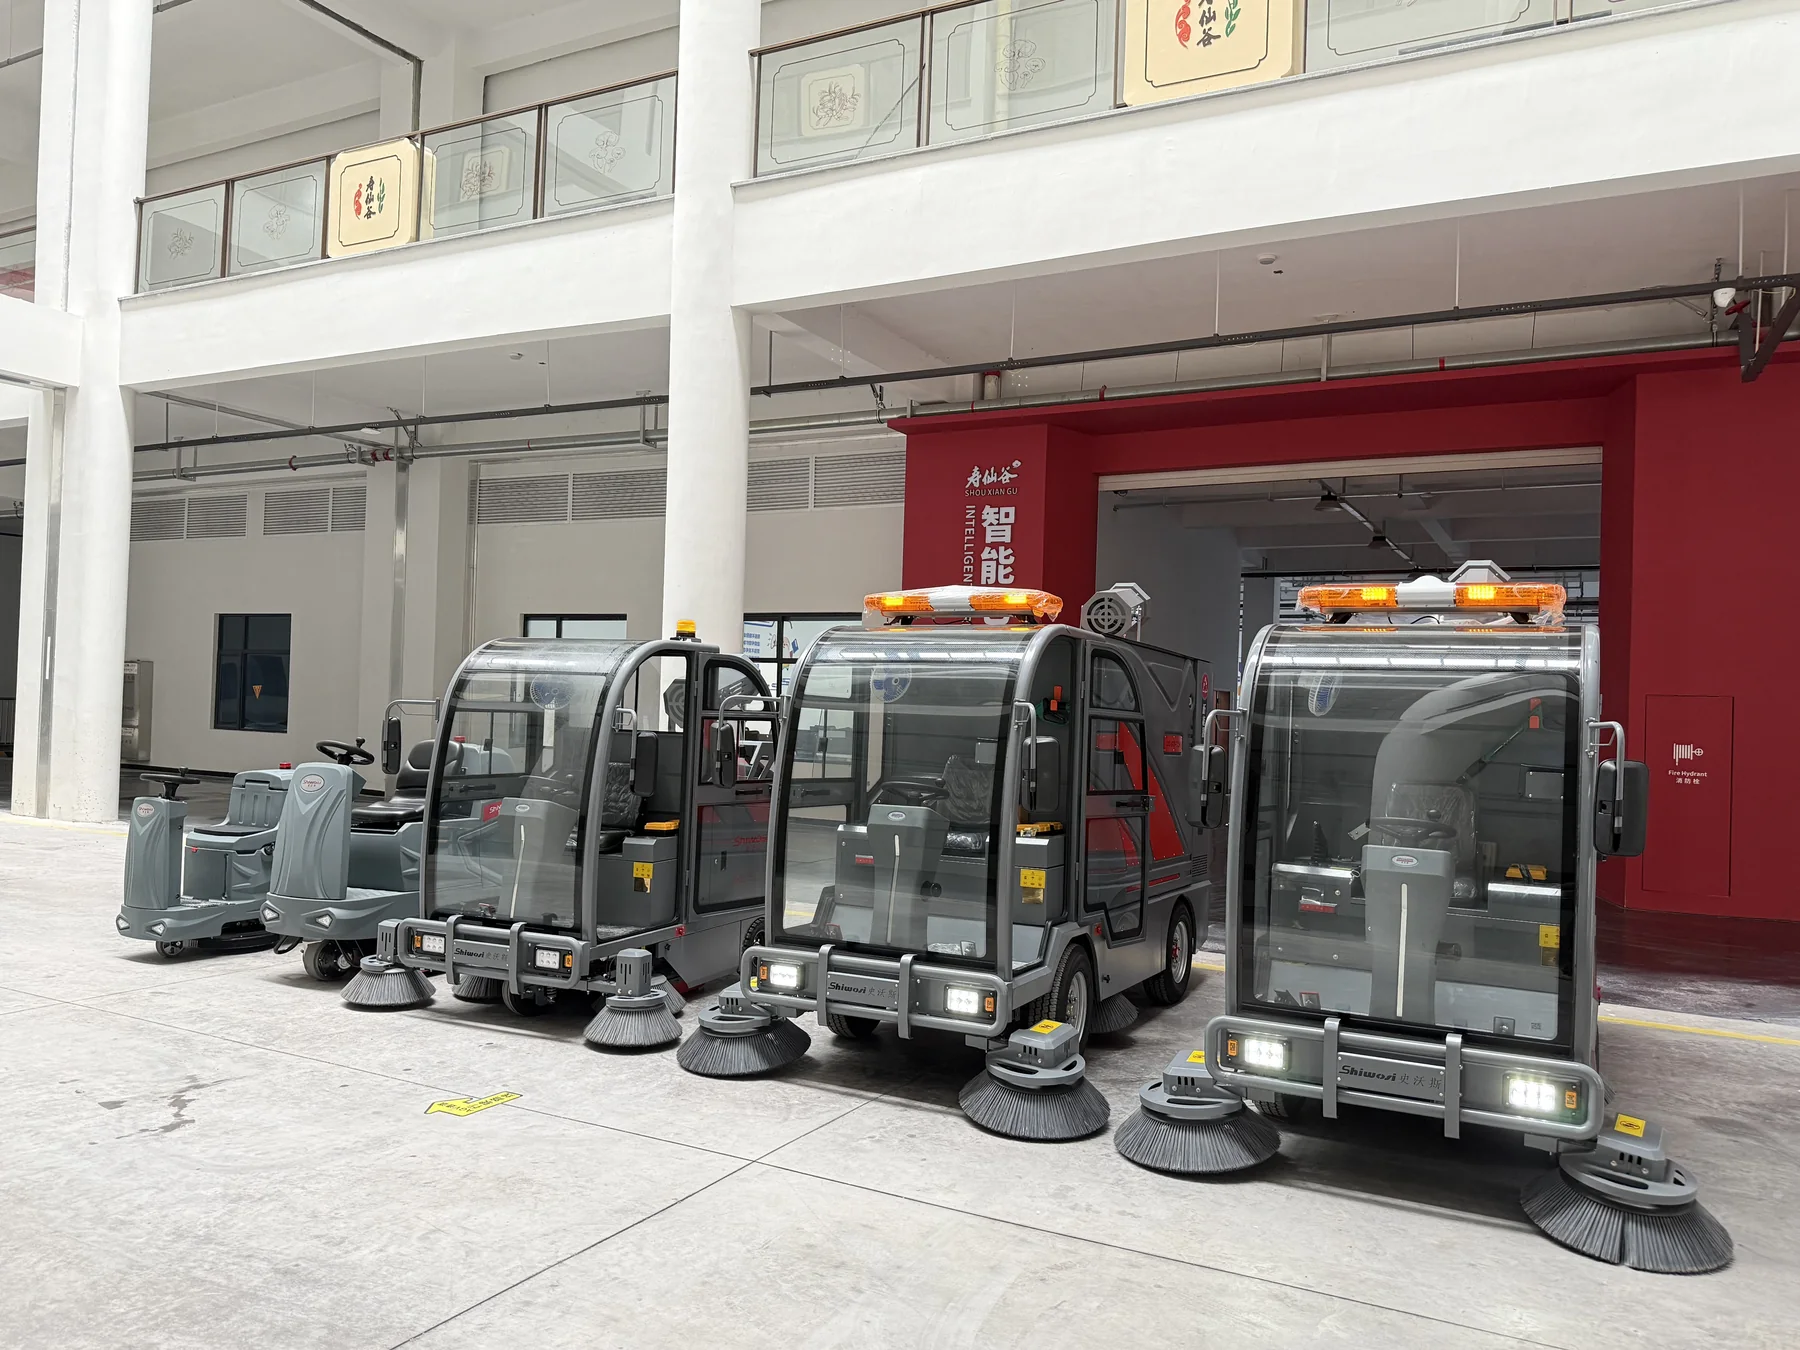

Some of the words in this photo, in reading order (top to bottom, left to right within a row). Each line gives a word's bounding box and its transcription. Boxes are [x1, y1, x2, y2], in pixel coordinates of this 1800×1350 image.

[965, 465, 1018, 488] 寿仙谷
[965, 489, 986, 497] SHOU
[1007, 487, 1018, 495] GU
[963, 505, 976, 586] INTELLIGEN
[1681, 770, 1708, 778] Hydrant
[453, 948, 485, 958] Shiwosi
[828, 981, 867, 994] Shiwosi
[1339, 1065, 1397, 1082] Shiwosi
[1400, 1073, 1442, 1090] 史沃斯
